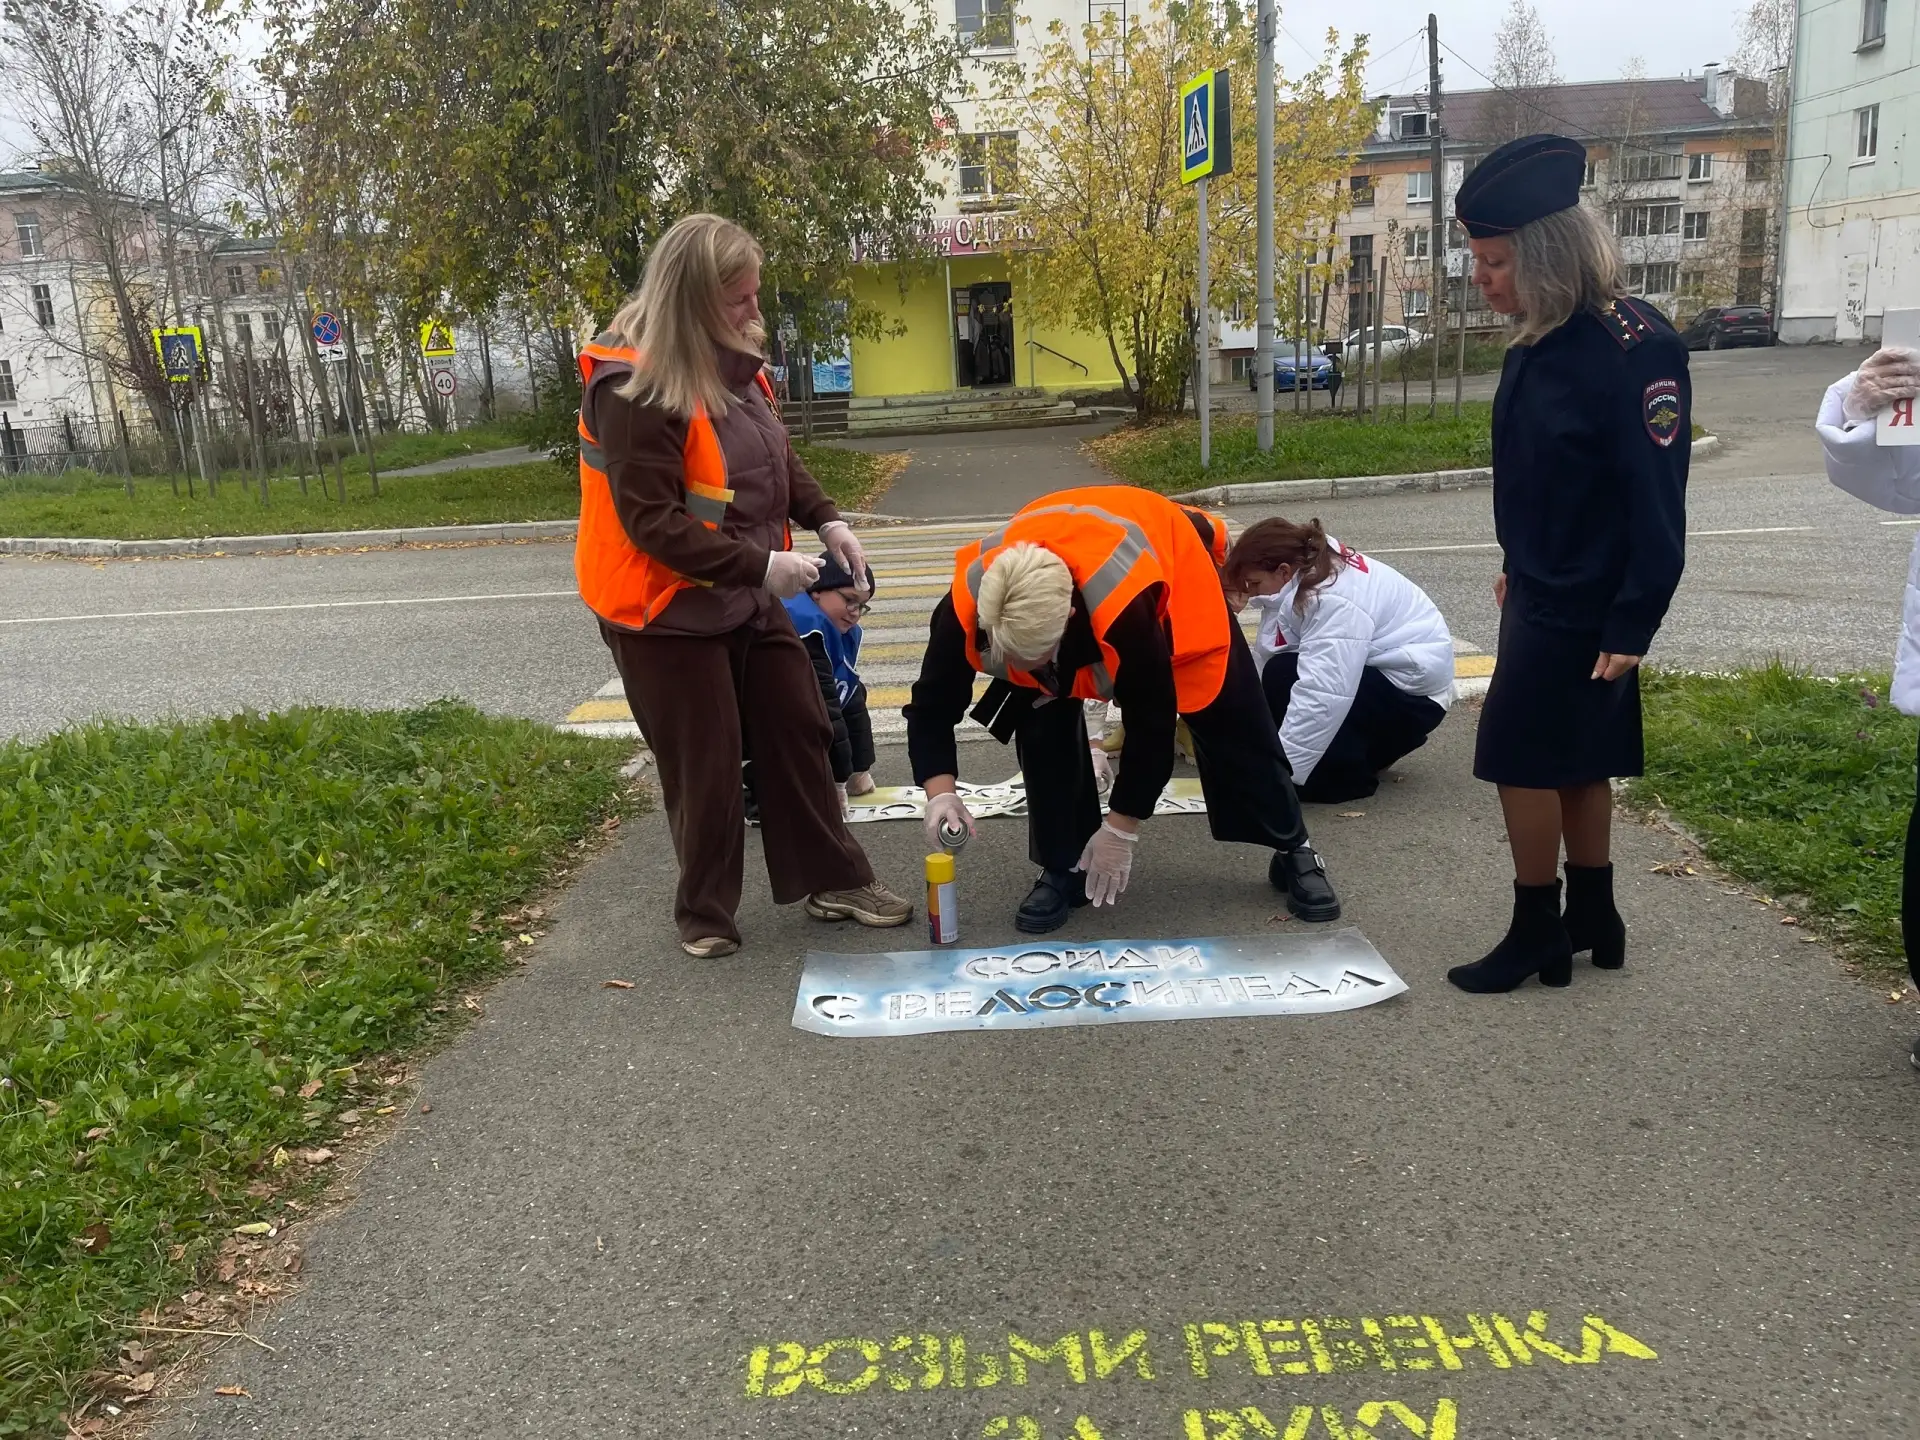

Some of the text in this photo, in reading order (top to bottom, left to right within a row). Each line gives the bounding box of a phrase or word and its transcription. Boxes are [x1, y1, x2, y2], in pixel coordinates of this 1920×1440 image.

[437, 378, 452, 389] 40
[1646, 380, 1676, 394] ПОЛИЦИЯ
[1648, 394, 1677, 410] РОССИЯ
[812, 970, 1387, 1020] С ВЕЛОСИПЕДА
[745, 1310, 1658, 1398] ВОЗЬМИ РЕБЕНКА
